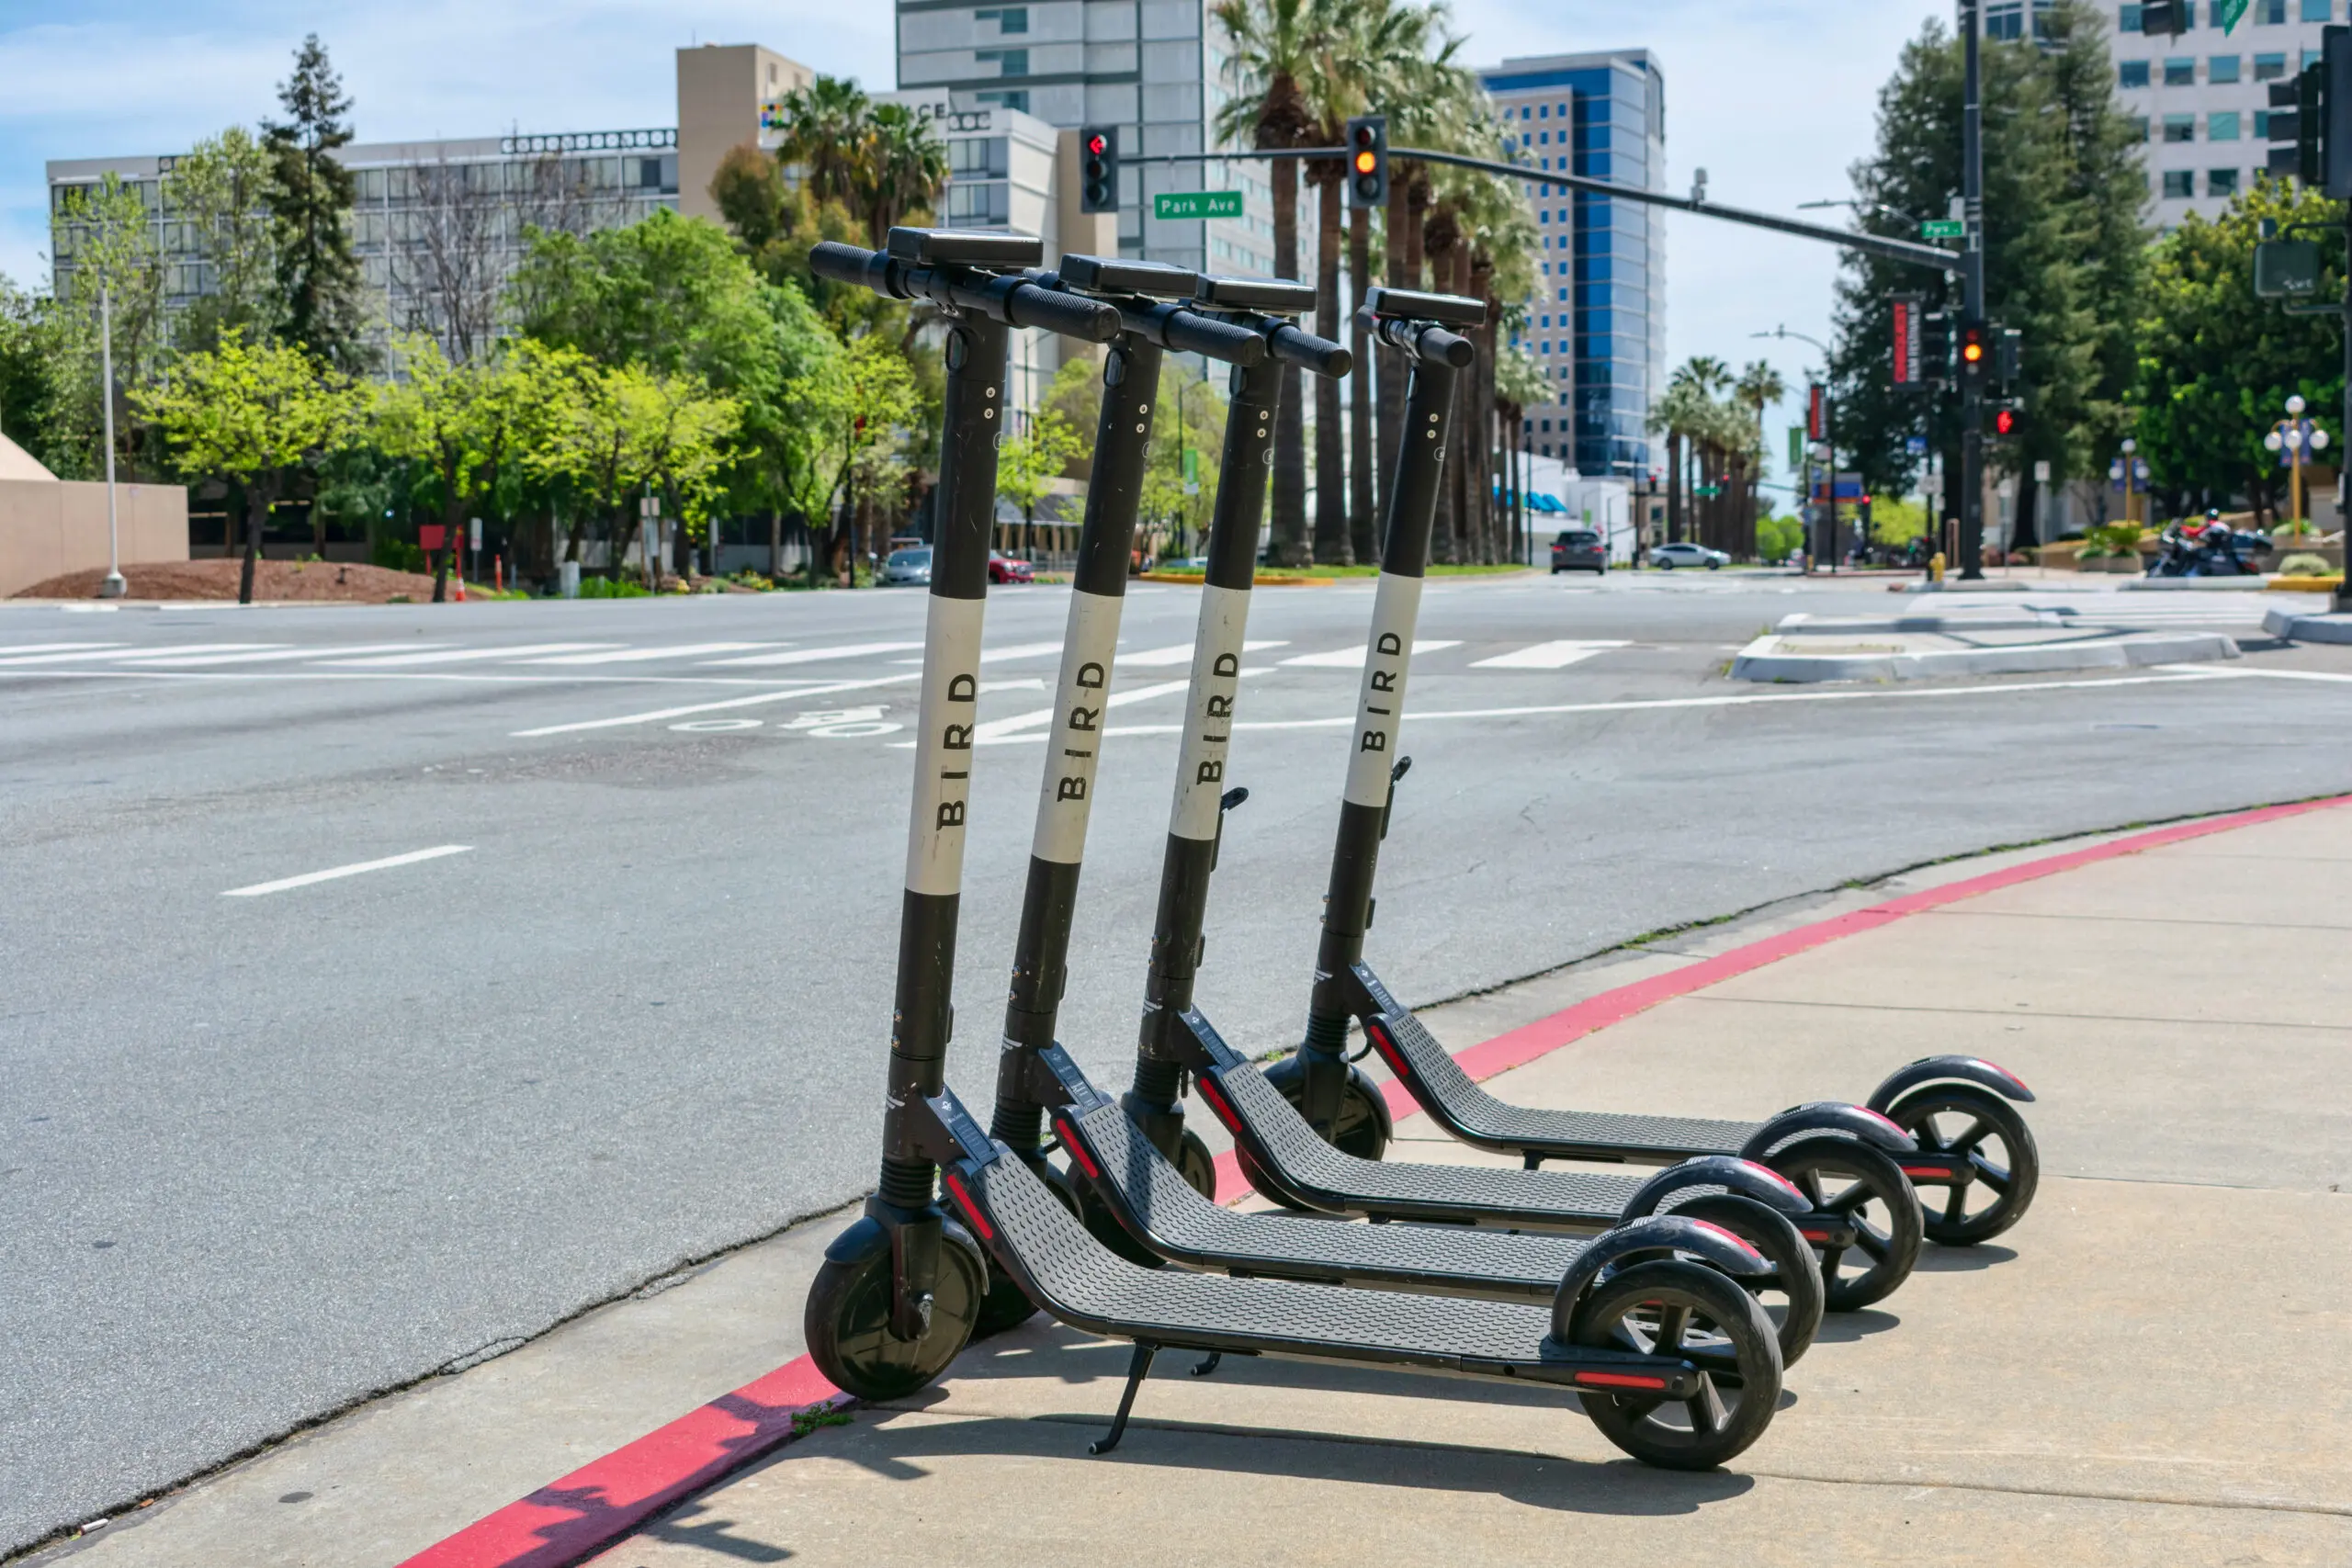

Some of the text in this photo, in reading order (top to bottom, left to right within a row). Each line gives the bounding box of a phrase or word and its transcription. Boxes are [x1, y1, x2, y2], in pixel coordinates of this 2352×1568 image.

[1161, 198, 1236, 213] Park Ave
[936, 673, 977, 830] BIRD
[1057, 661, 1104, 802] BIRD
[1196, 653, 1238, 784] BIRD
[1361, 632, 1401, 752] BIRD
